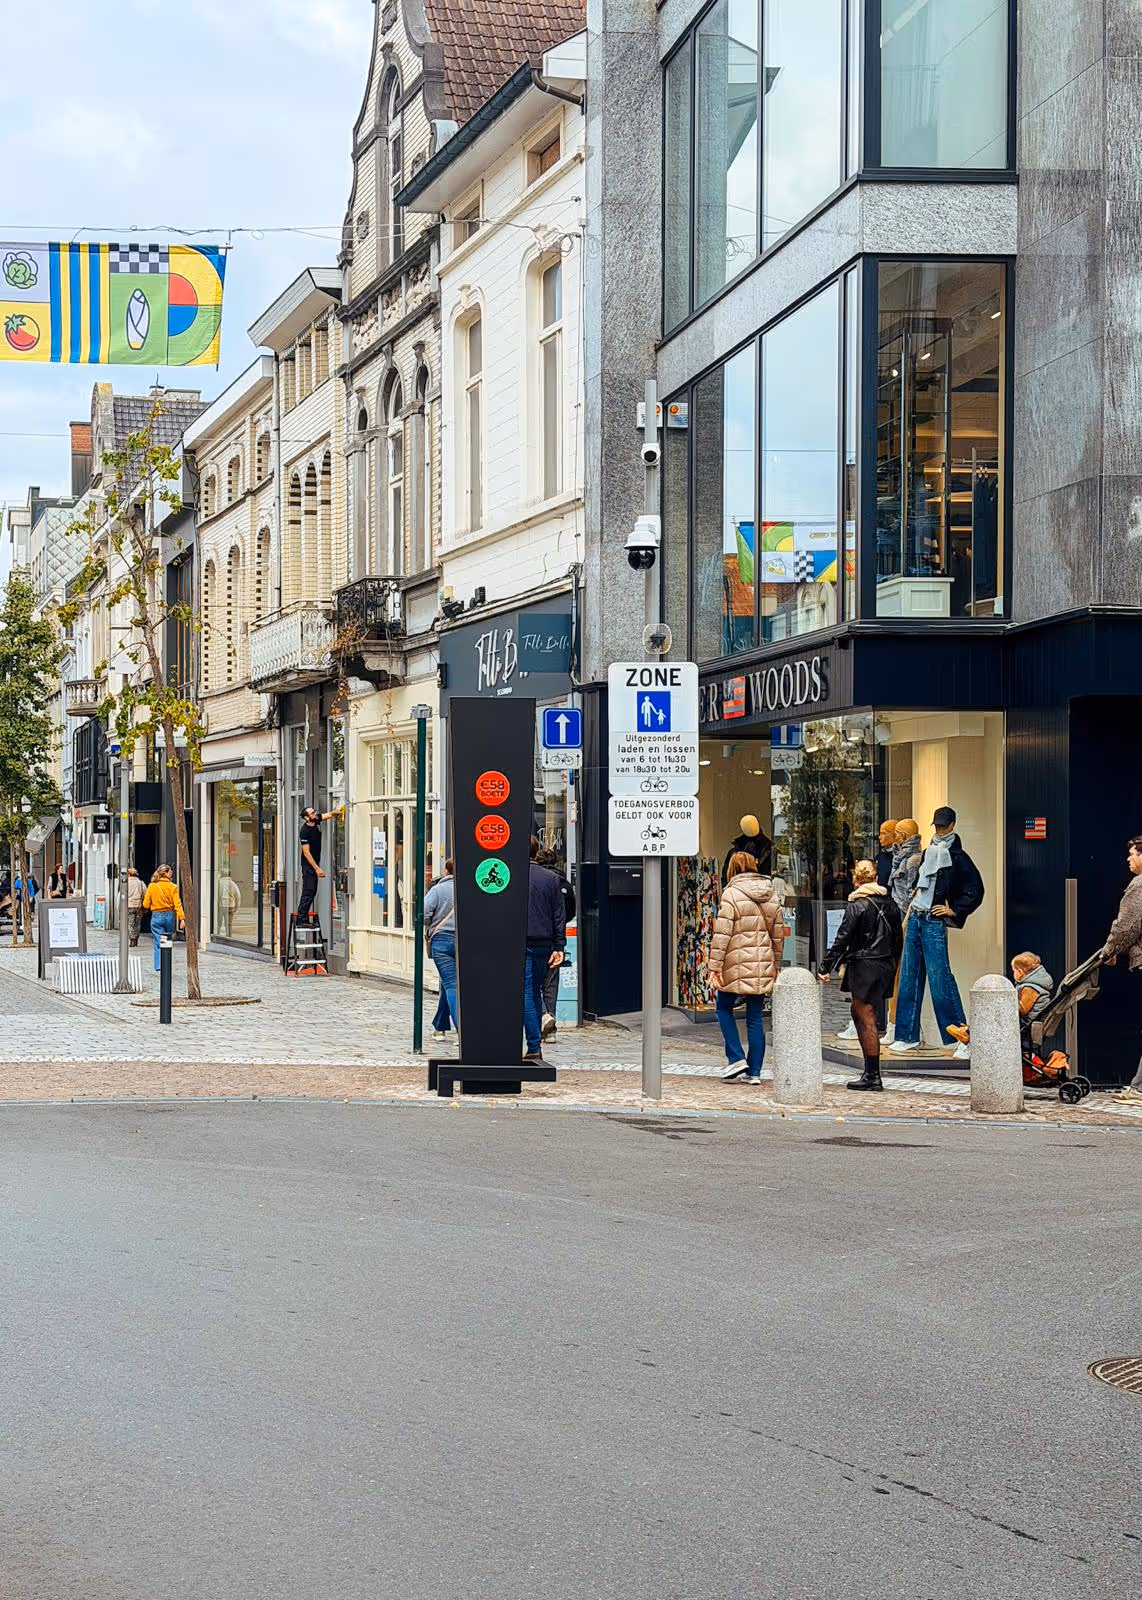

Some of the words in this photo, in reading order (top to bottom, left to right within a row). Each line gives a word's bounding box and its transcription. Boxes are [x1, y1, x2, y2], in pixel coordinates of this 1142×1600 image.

[626, 668, 682, 687] ZONE
[749, 656, 821, 714] WOODS
[625, 734, 681, 743] Uitgezonderd
[617, 744, 644, 753] laden
[664, 744, 696, 753] lossen
[639, 755, 645, 763] 6
[664, 755, 687, 763] 11u30
[633, 765, 657, 773] 18u30
[675, 765, 691, 773] 20u
[480, 779, 505, 790] €58
[613, 800, 695, 808] TOEGANGSVERBOD
[615, 811, 643, 819] GELDT
[646, 811, 664, 819] OOK
[668, 811, 692, 819] VOOR
[480, 823, 505, 834] €58
